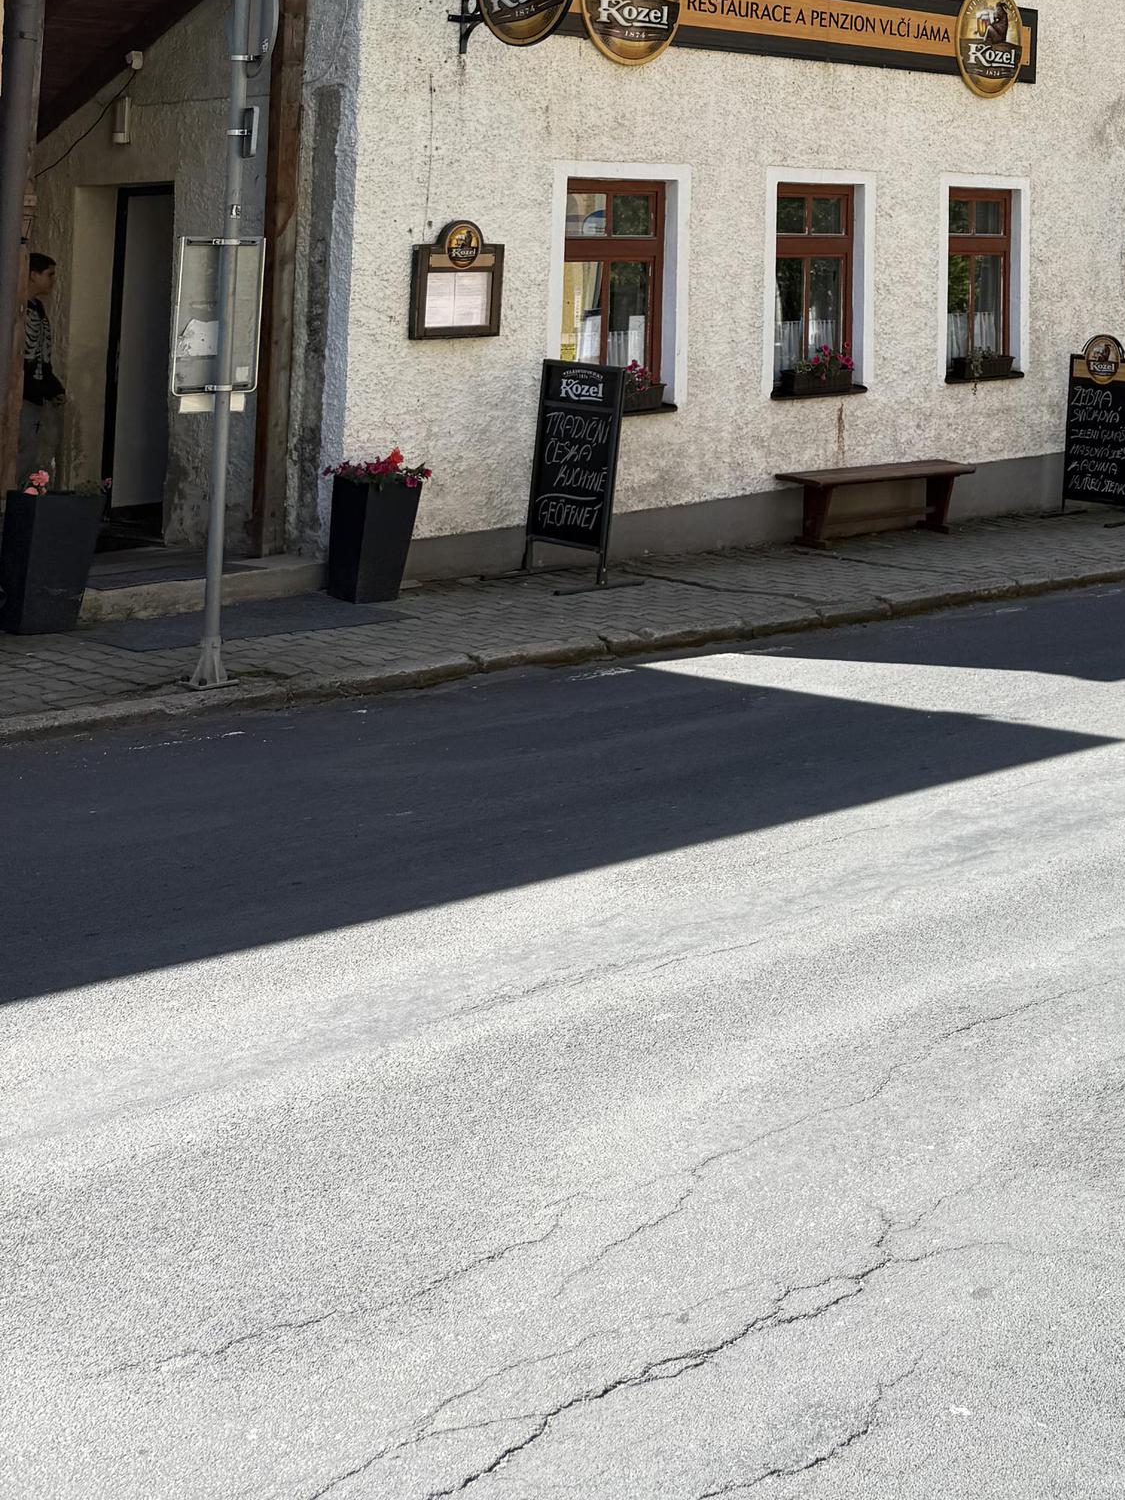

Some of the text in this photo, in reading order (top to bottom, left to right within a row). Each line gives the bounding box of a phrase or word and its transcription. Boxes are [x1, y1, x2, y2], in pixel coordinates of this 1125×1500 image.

[515, 5, 535, 17] 1874
[795, 8, 807, 25] A
[811, 10, 876, 33] PENZION
[879, 17, 911, 38] VLČÍ
[913, 20, 951, 43] JÁMA
[624, 30, 646, 38] 1874
[967, 43, 1015, 68] Kozel
[451, 248, 476, 258] Kozel
[1090, 362, 1115, 371] Kozel
[560, 379, 603, 401] Kozel
